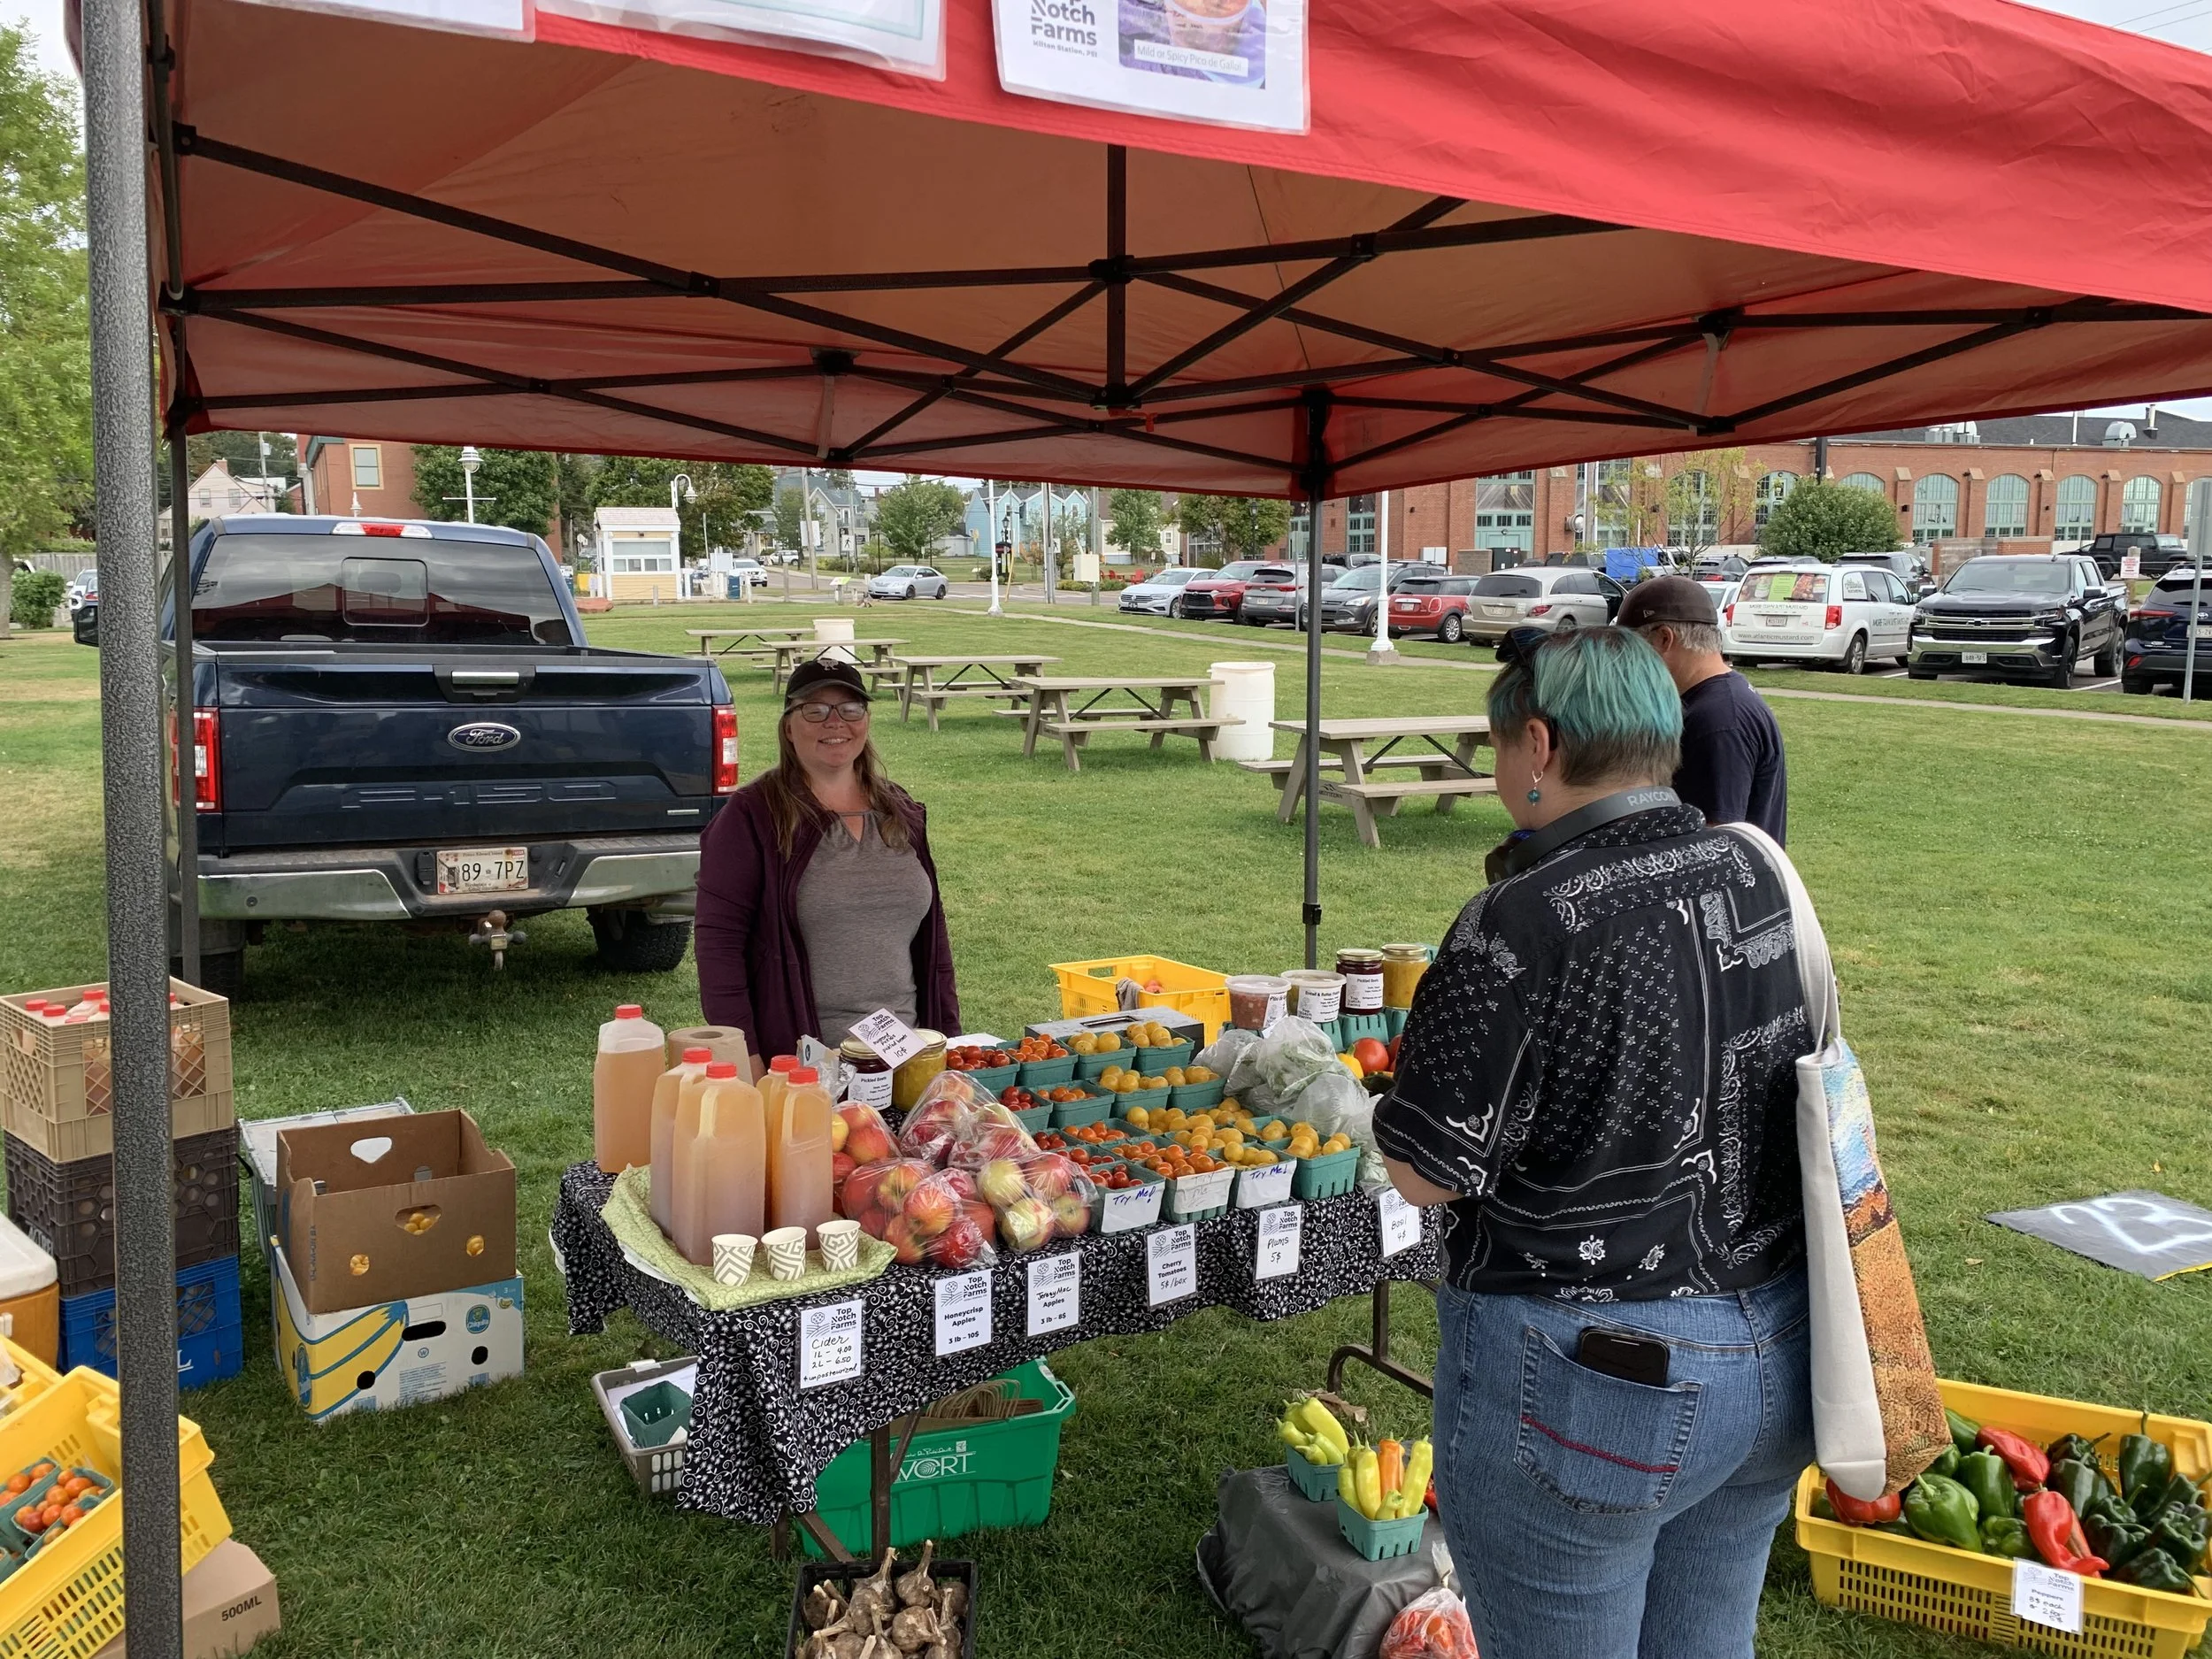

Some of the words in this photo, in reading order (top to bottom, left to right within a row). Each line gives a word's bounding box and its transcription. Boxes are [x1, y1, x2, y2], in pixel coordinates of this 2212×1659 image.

[1031, 16, 1097, 46] Farms
[1136, 45, 1156, 57] Mild
[1156, 50, 1165, 58] or
[1166, 50, 1189, 65] Spicy
[1189, 53, 1207, 65] Pico
[1208, 57, 1218, 67] de
[465, 728, 504, 745] Ford
[1626, 791, 1675, 807] RAYCON
[462, 863, 481, 881] 89
[494, 860, 525, 880] 7PZ
[873, 1015, 891, 1026] Notch
[878, 1018, 895, 1031] Farms
[1250, 1171, 1266, 1179] Try
[1270, 1164, 1288, 1175] Me!
[1113, 1194, 1131, 1205] Try
[1171, 1234, 1191, 1245] Notch
[1267, 1236, 1289, 1249] Plums
[1171, 1240, 1192, 1251] Farms
[1271, 1251, 1281, 1263] 5$
[1054, 1263, 1075, 1273] Notch
[1162, 1259, 1182, 1270] Cherry
[1053, 1270, 1076, 1279] Farms
[1157, 1266, 1187, 1279] Tomatoes
[964, 1281, 987, 1291] Notch
[963, 1288, 987, 1298] Farms
[1042, 1298, 1064, 1308] Apples
[831, 1312, 856, 1323] Notch
[944, 1306, 984, 1320] Honeycrisp
[831, 1319, 856, 1330] Farms
[952, 1317, 976, 1327] Apples
[811, 1336, 849, 1349] Cider
[837, 1345, 852, 1355] 4.00
[2048, 1576, 2074, 1586] Notch
[2054, 1572, 2070, 1581] Top
[2047, 1581, 2074, 1591] Farms
[2032, 1588, 2063, 1601] Peppers
[221, 1595, 263, 1622] 500ML
